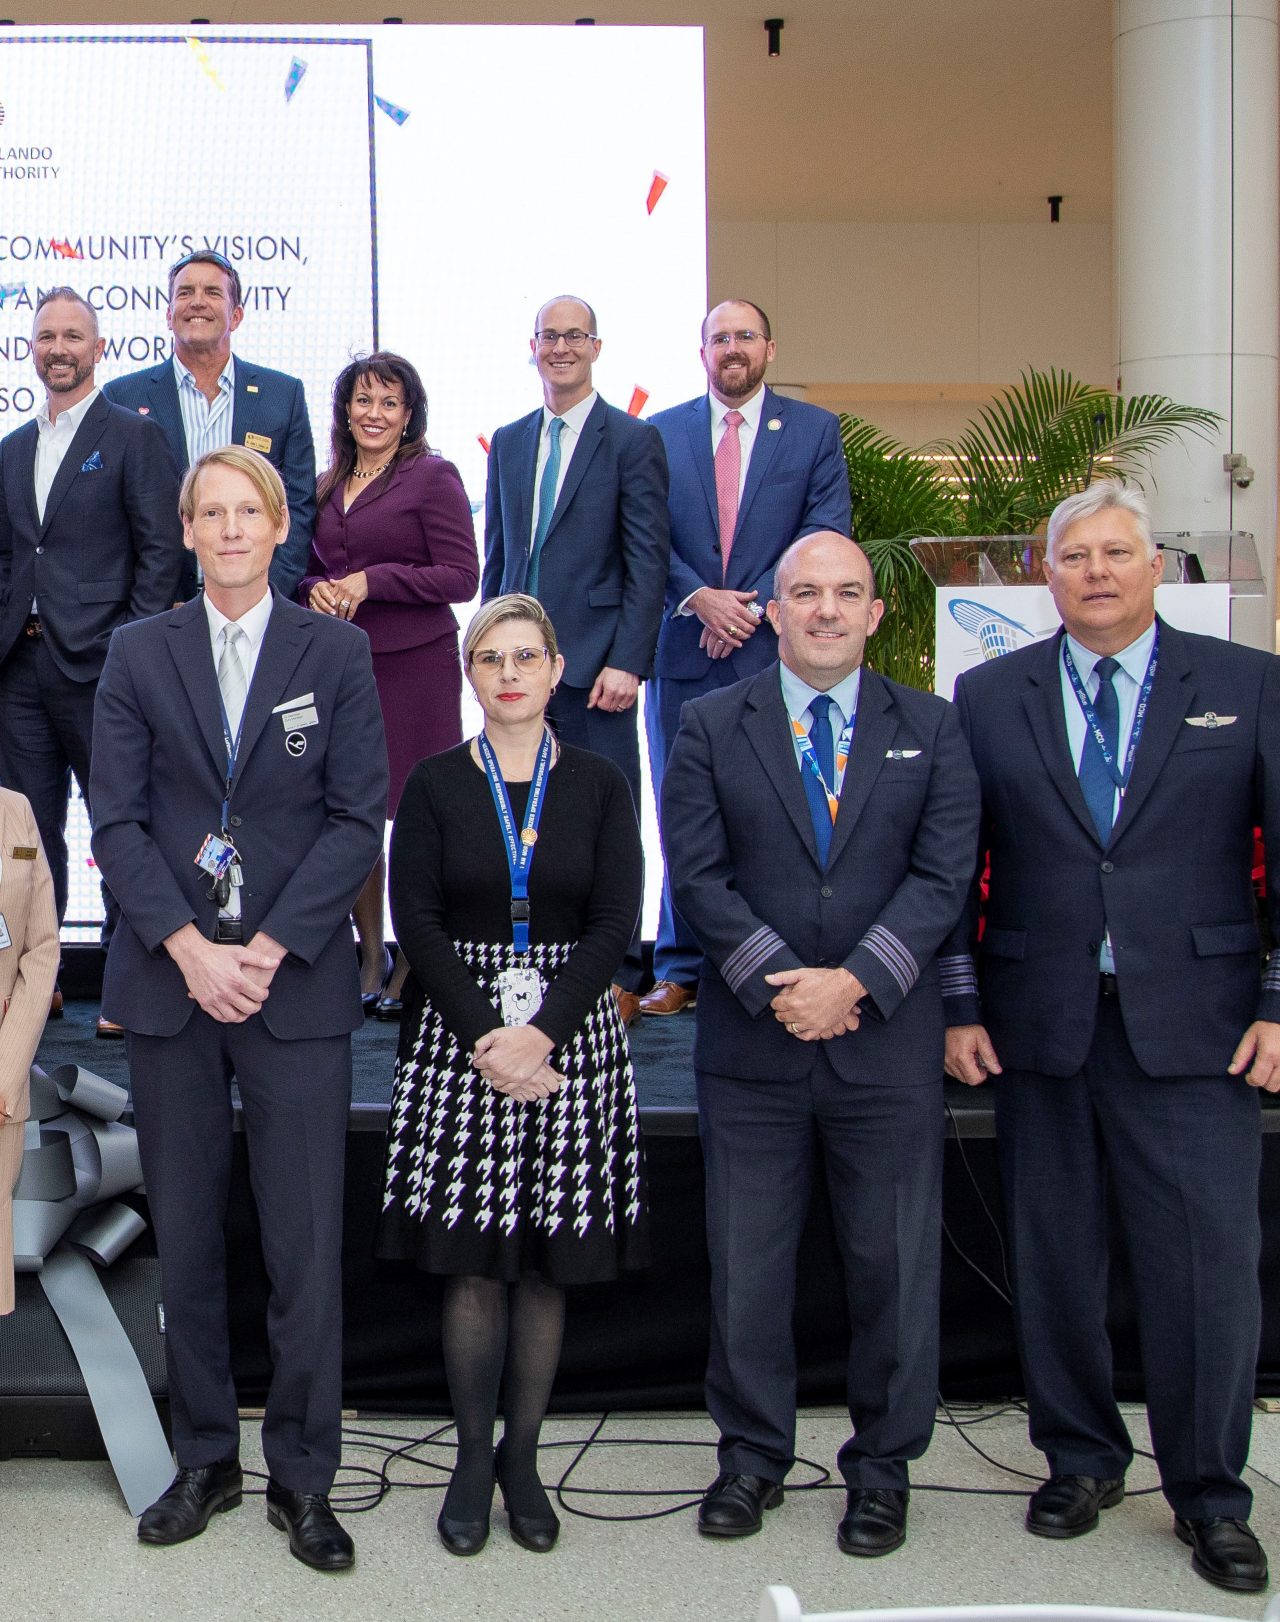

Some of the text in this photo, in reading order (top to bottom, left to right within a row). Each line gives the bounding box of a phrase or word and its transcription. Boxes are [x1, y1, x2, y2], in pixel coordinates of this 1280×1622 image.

[203, 235, 309, 266] VISION,
[14, 285, 57, 312] AN
[1136, 703, 1147, 718] MCO
[1094, 728, 1106, 744] MCO
[487, 758, 499, 782] OPERATING
[503, 815, 512, 834] SAFELY
[531, 788, 540, 813] OPERATING
